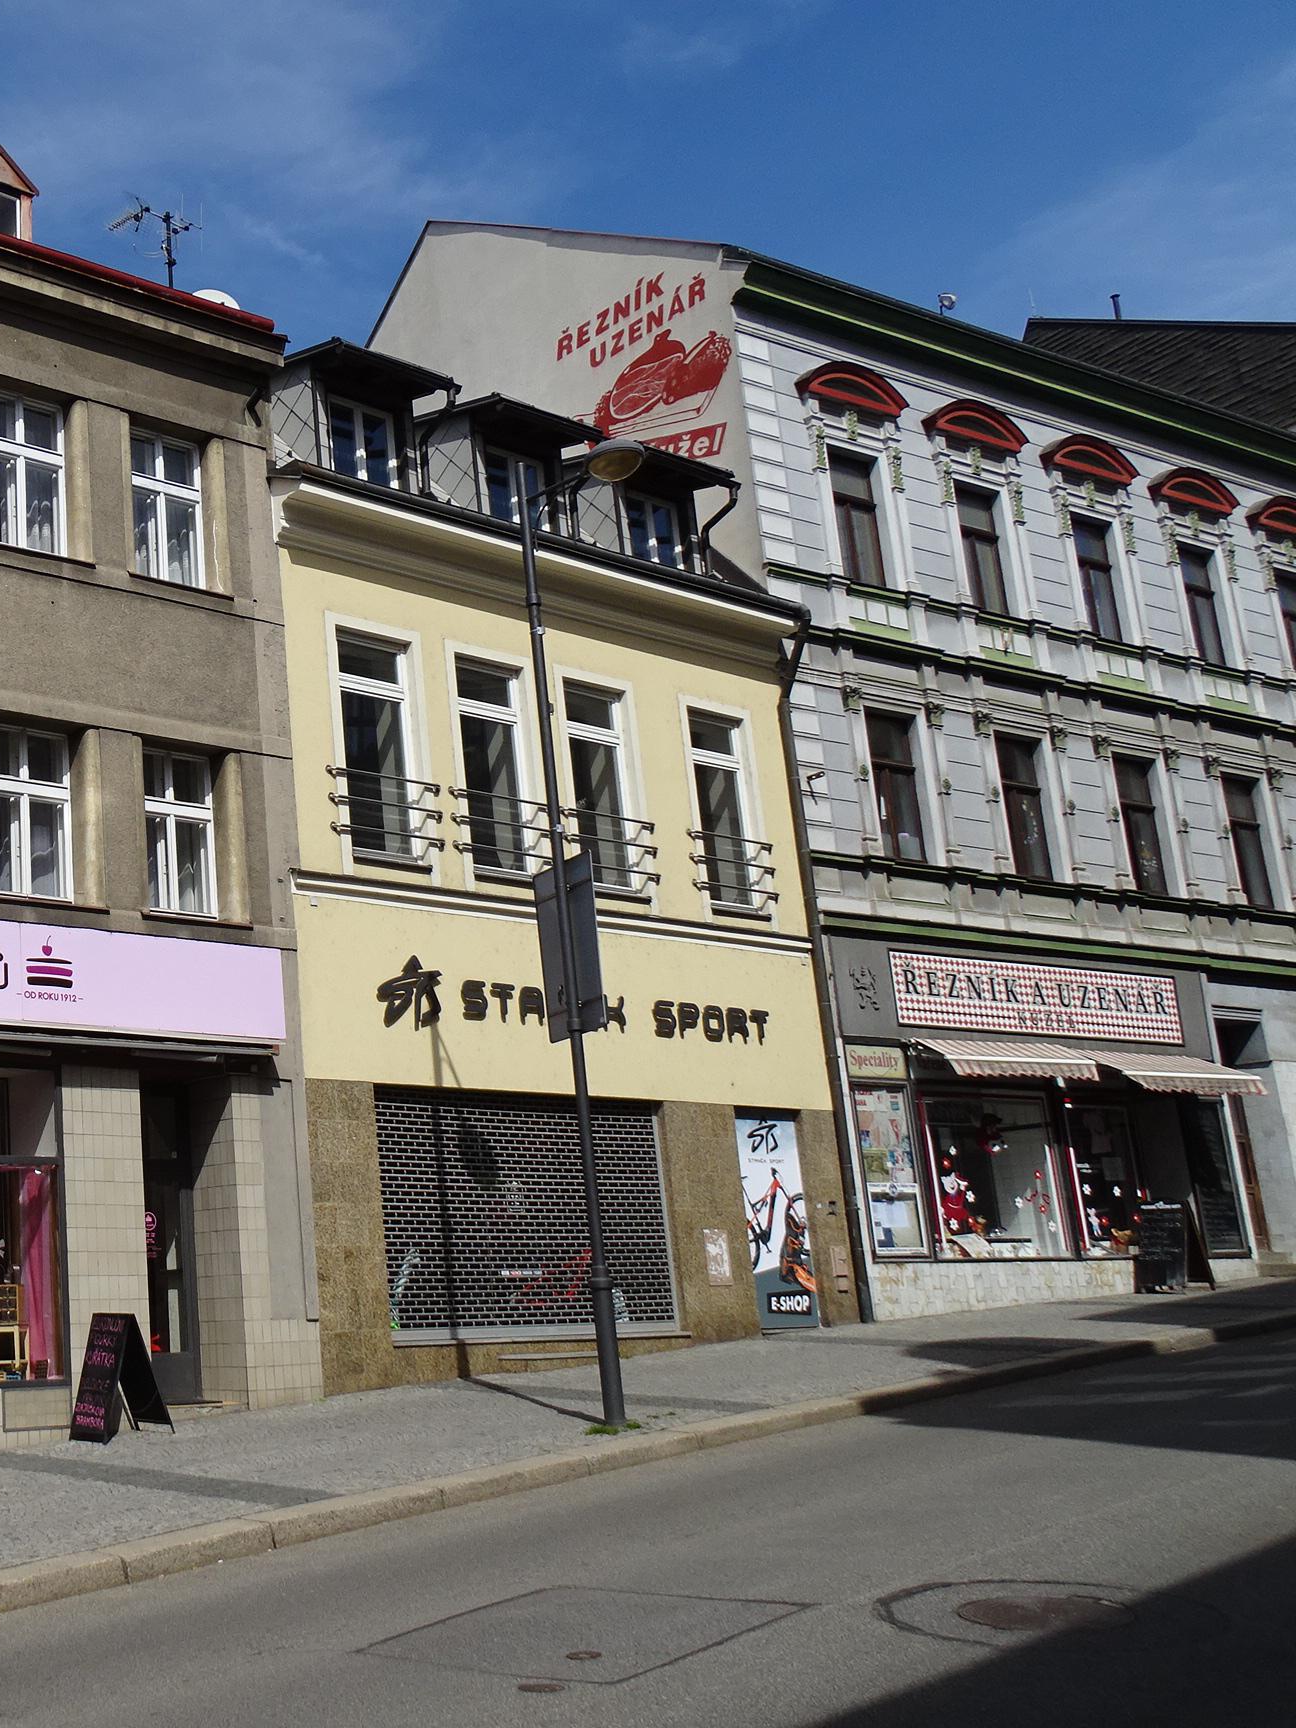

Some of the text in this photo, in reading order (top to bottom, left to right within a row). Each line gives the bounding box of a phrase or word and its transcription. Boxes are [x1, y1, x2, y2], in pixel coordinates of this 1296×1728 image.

[557, 271, 665, 361] ŘEZNÍK
[589, 272, 706, 368] UZENÁŘ
[24, 990, 77, 1002] OD ROKU 1912
[461, 979, 769, 1046] STAK SPORT
[903, 962, 1168, 1015] ŘEZNÍK A UZENÁŘ
[849, 1049, 899, 1071] Speciality
[770, 1295, 810, 1312] E-SHOP
